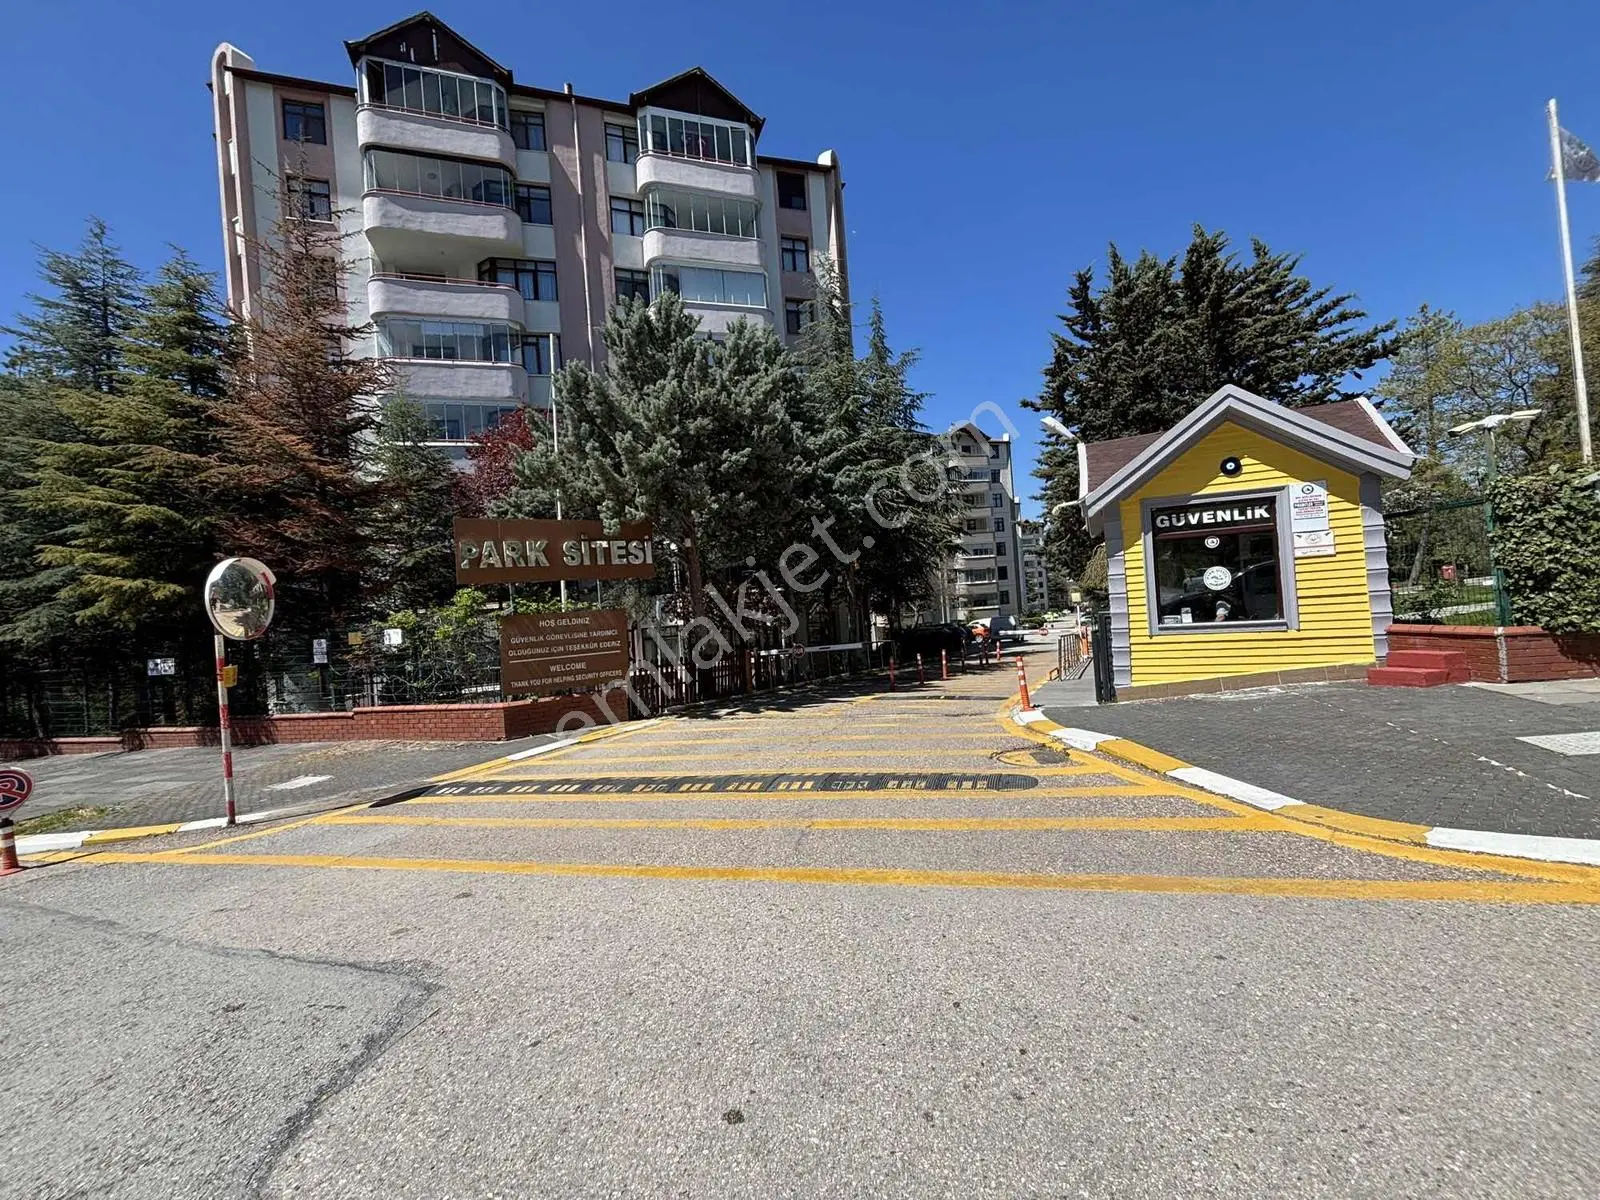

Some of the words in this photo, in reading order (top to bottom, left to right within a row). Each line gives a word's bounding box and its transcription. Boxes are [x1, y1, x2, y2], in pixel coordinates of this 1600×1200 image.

[1155, 504, 1271, 528] GÜVENLİK
[458, 540, 550, 569] PARK
[562, 534, 653, 567] SİTESİ
[549, 662, 587, 673] WELCOME
[510, 680, 530, 688] THANK
[541, 677, 552, 685] FOR
